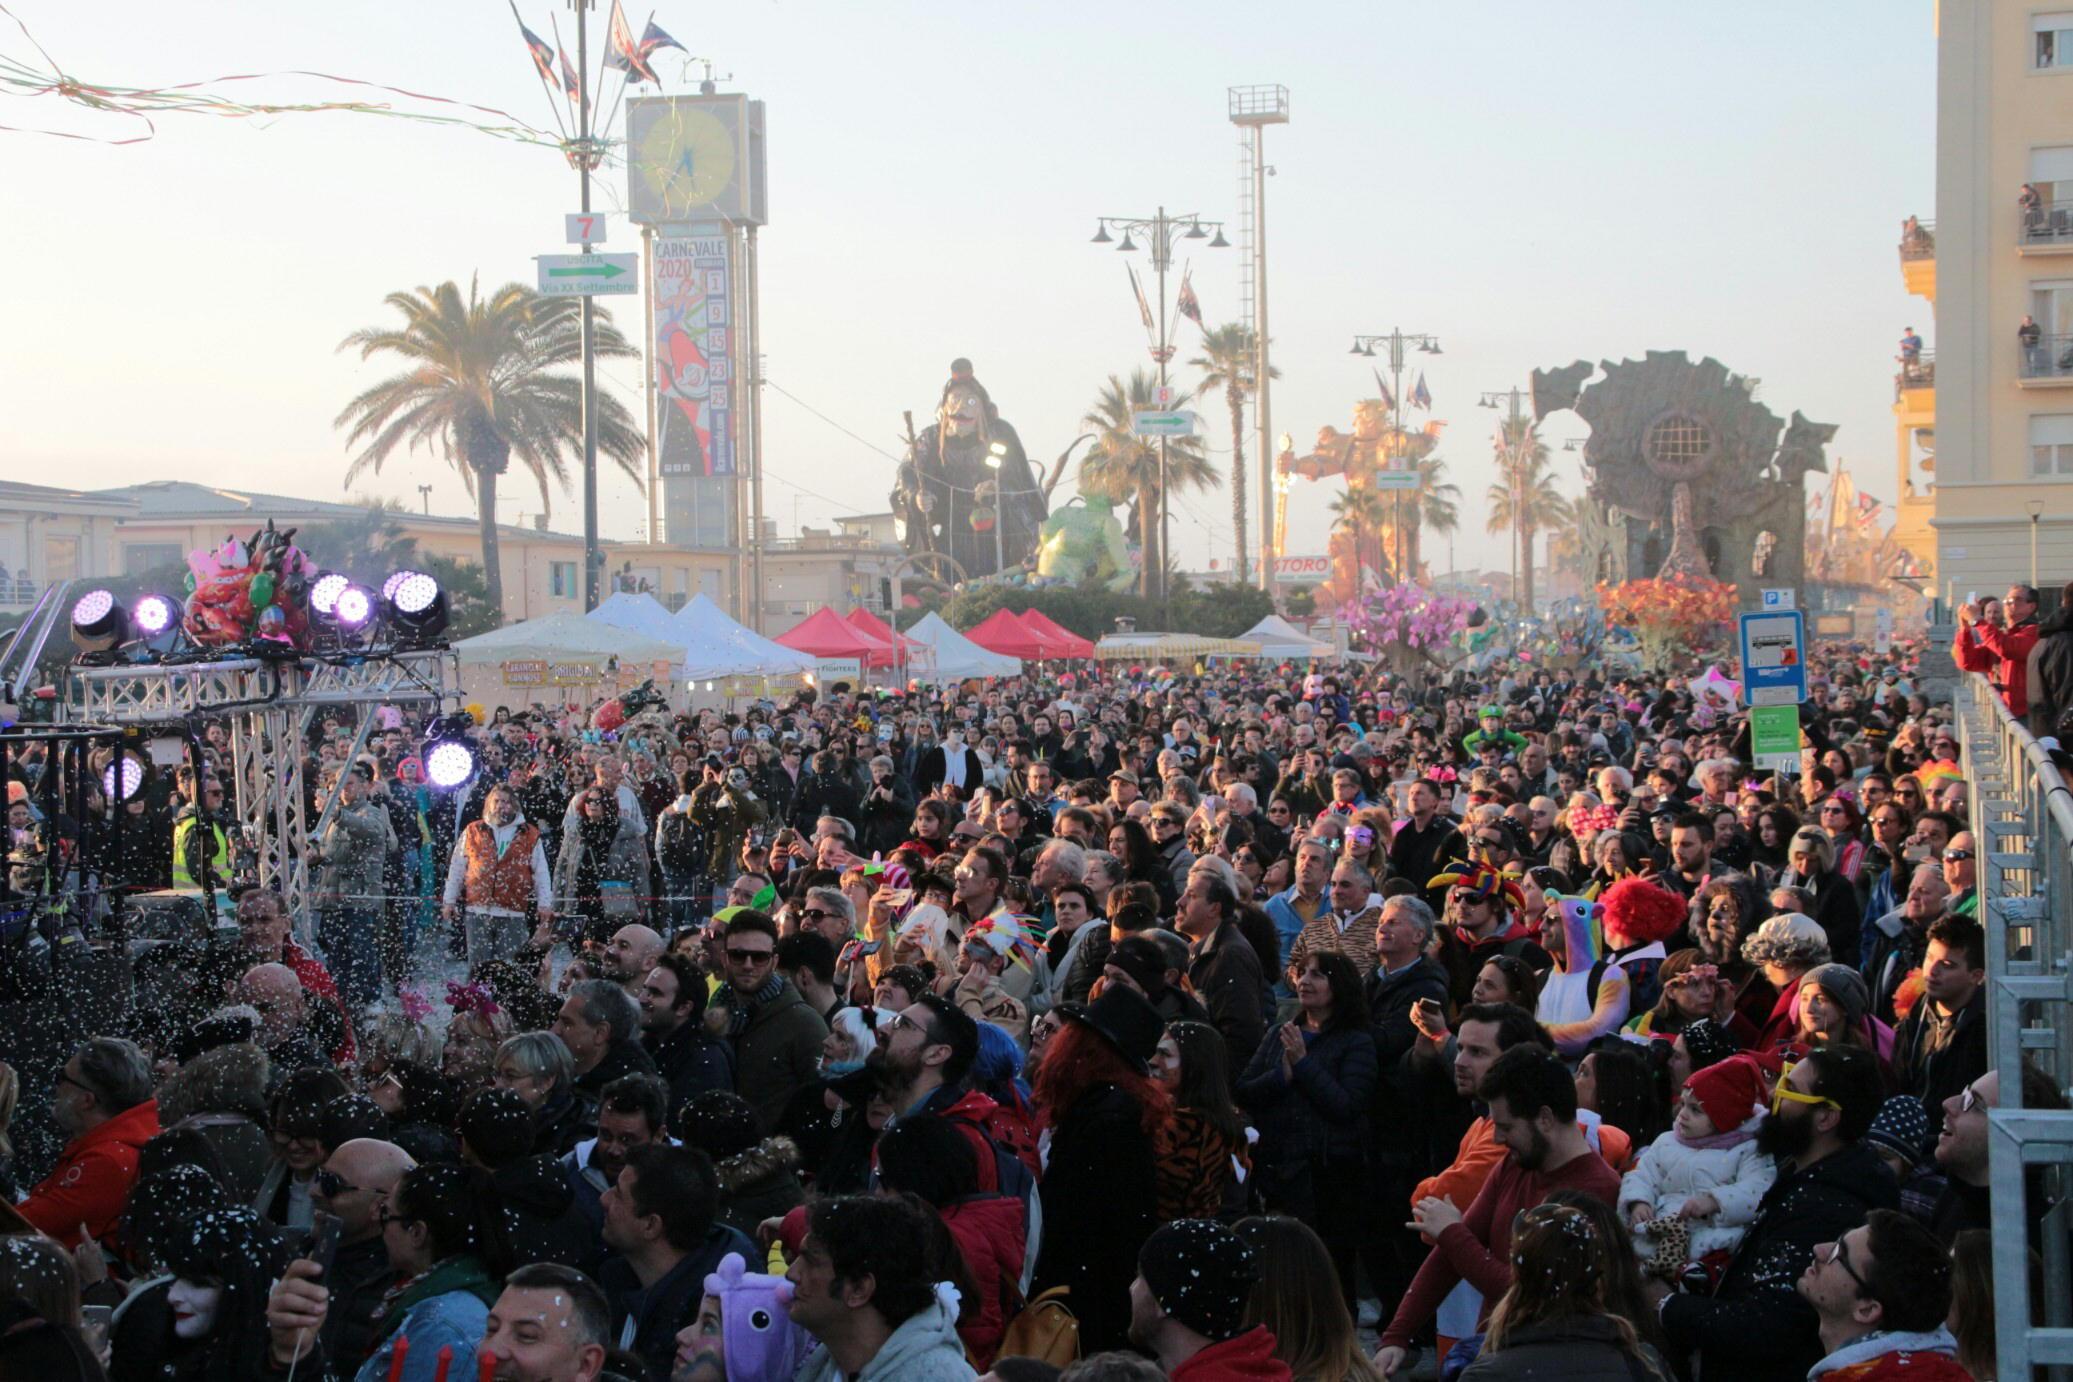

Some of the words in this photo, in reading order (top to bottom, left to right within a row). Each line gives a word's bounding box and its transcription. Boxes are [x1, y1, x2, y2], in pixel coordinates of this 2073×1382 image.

[577, 217, 594, 239] 7
[655, 241, 725, 258] CARNEVALE
[567, 254, 603, 265] USCITA
[657, 259, 692, 279] 2020
[541, 282, 559, 293] Via
[561, 282, 573, 292] XX
[576, 281, 636, 292] Settembre
[711, 277, 719, 291] 1
[712, 306, 721, 320] 9
[711, 336, 724, 348] 15
[711, 361, 725, 377] 23
[711, 392, 726, 405] 25
[1158, 388, 1169, 401] 8
[1254, 558, 1329, 573] STORO
